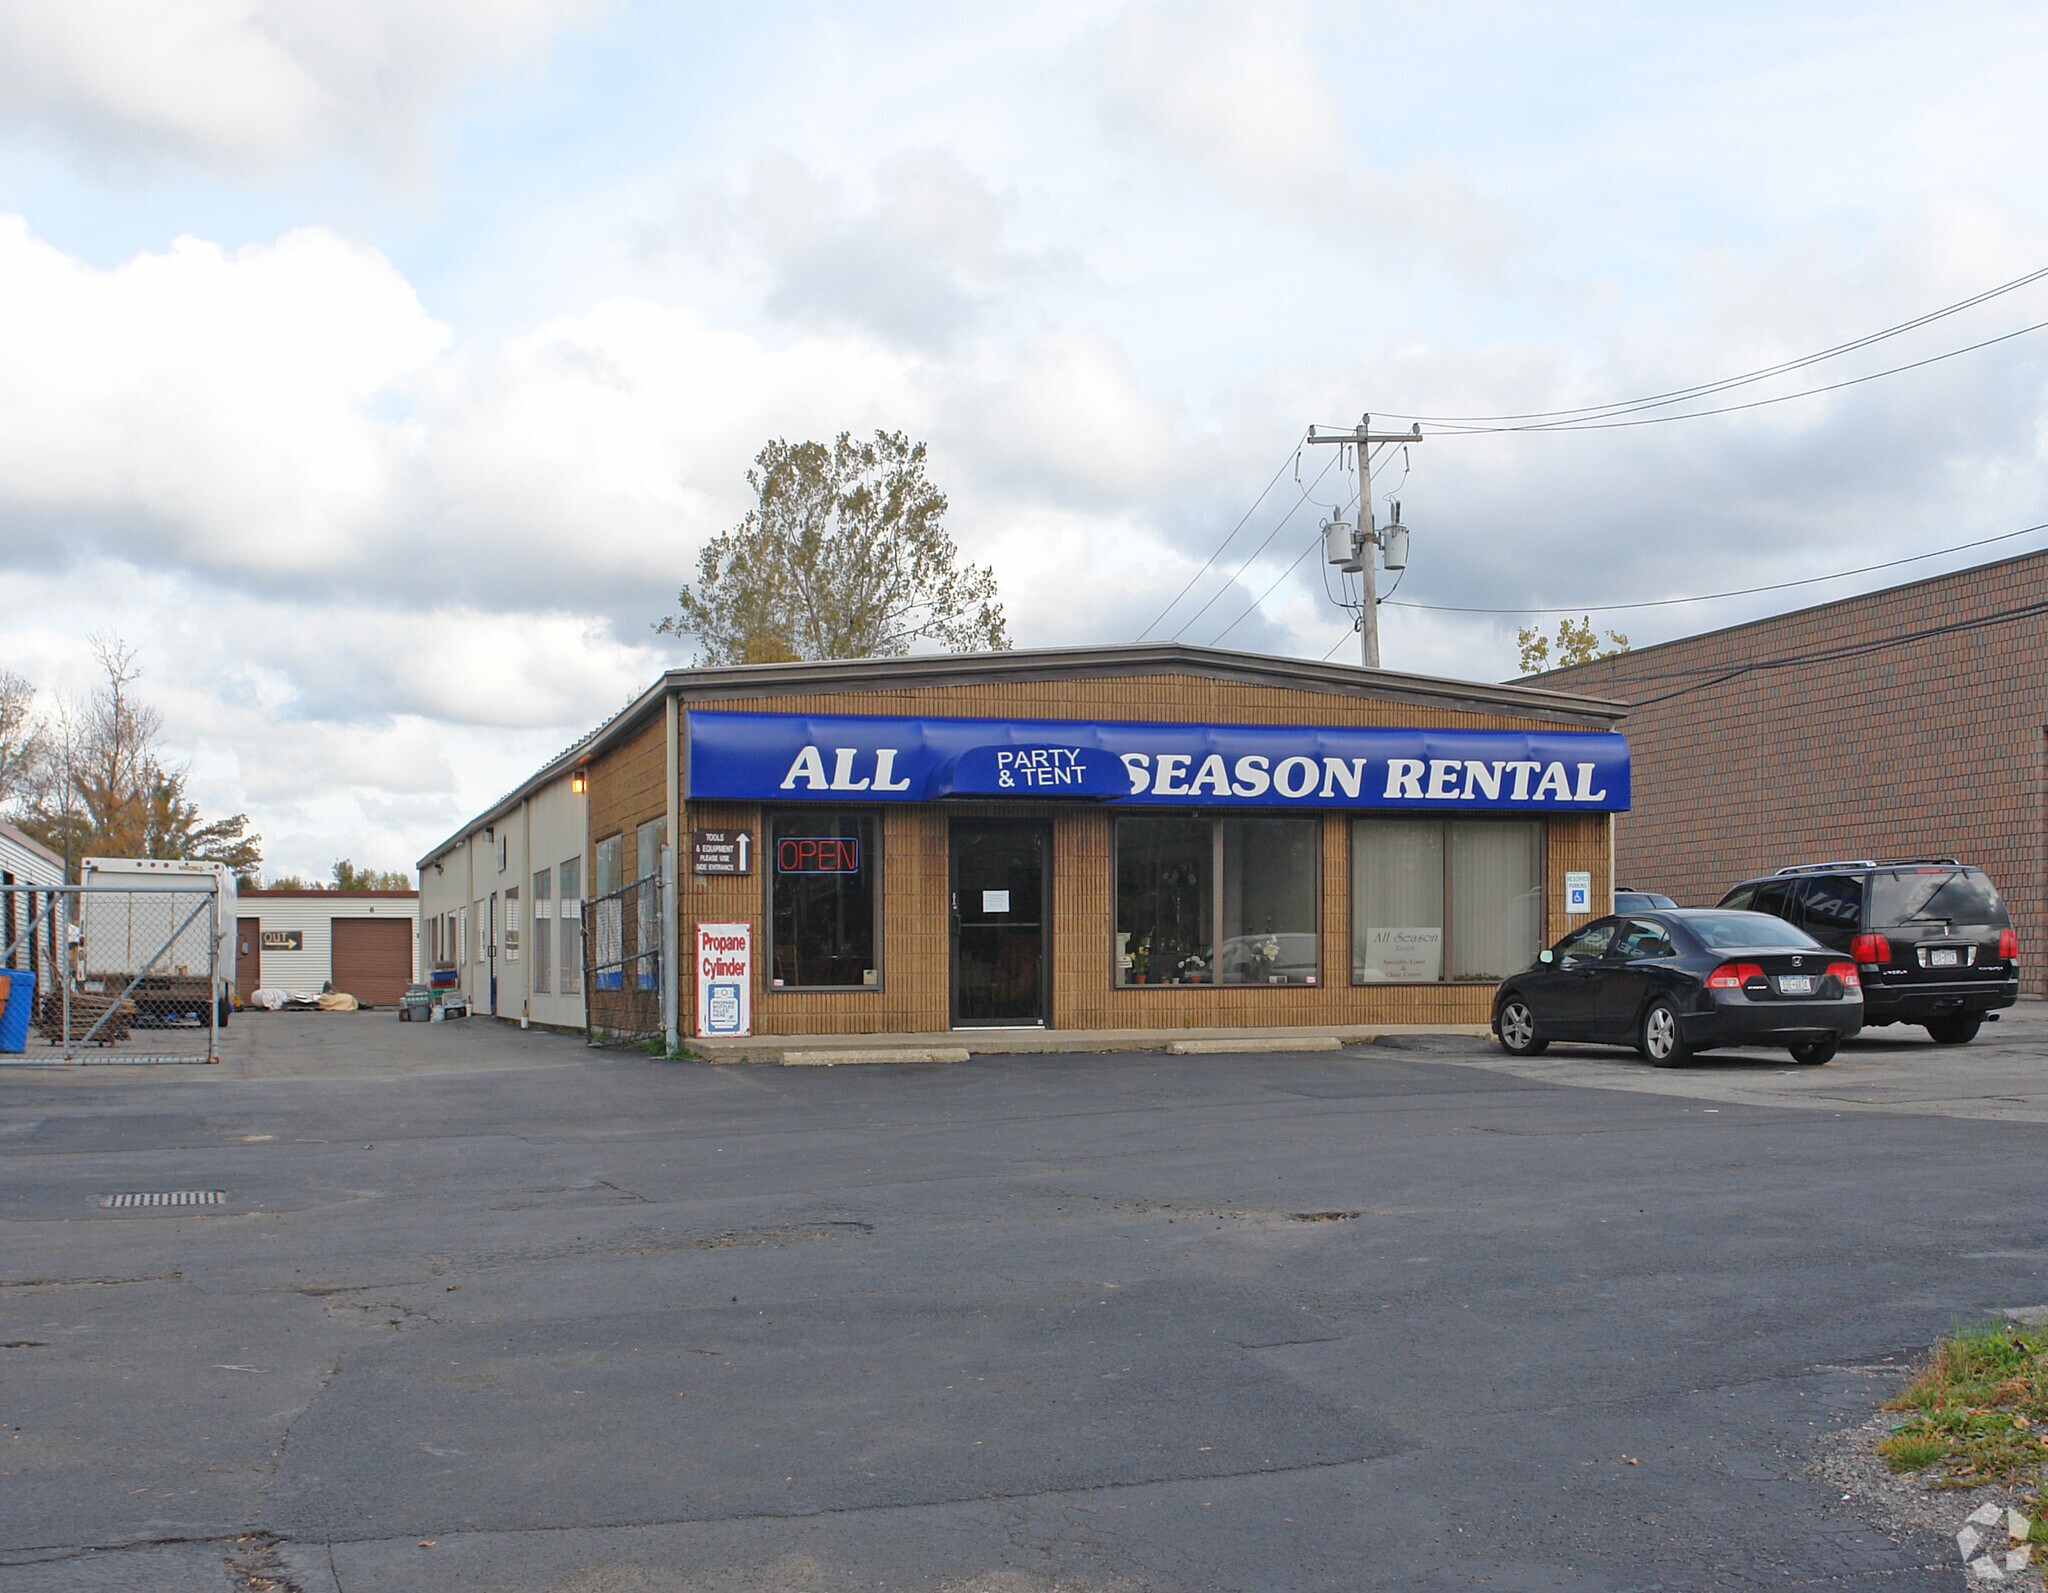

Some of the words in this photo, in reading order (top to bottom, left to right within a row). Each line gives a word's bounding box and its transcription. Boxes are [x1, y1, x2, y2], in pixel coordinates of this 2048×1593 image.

[997, 749, 1080, 770] PARTY
[780, 745, 911, 791] ALL
[1120, 752, 1368, 799] SEASON
[1383, 759, 1607, 802] RENTAL
[998, 769, 1015, 787] &
[1020, 766, 1087, 786] TENT
[706, 833, 725, 842] TOOLS
[702, 844, 734, 853] EQUIPMENT
[779, 840, 856, 871] OPEN
[700, 854, 718, 862] PLEASE
[719, 854, 730, 862] USE
[695, 863, 708, 871] SIDE
[708, 863, 735, 871] ENTRANCE
[263, 932, 288, 943] OUT
[702, 932, 746, 955] Propane
[1374, 932, 1391, 943] All
[1394, 931, 1438, 943] Season
[702, 957, 746, 980] Cylinder
